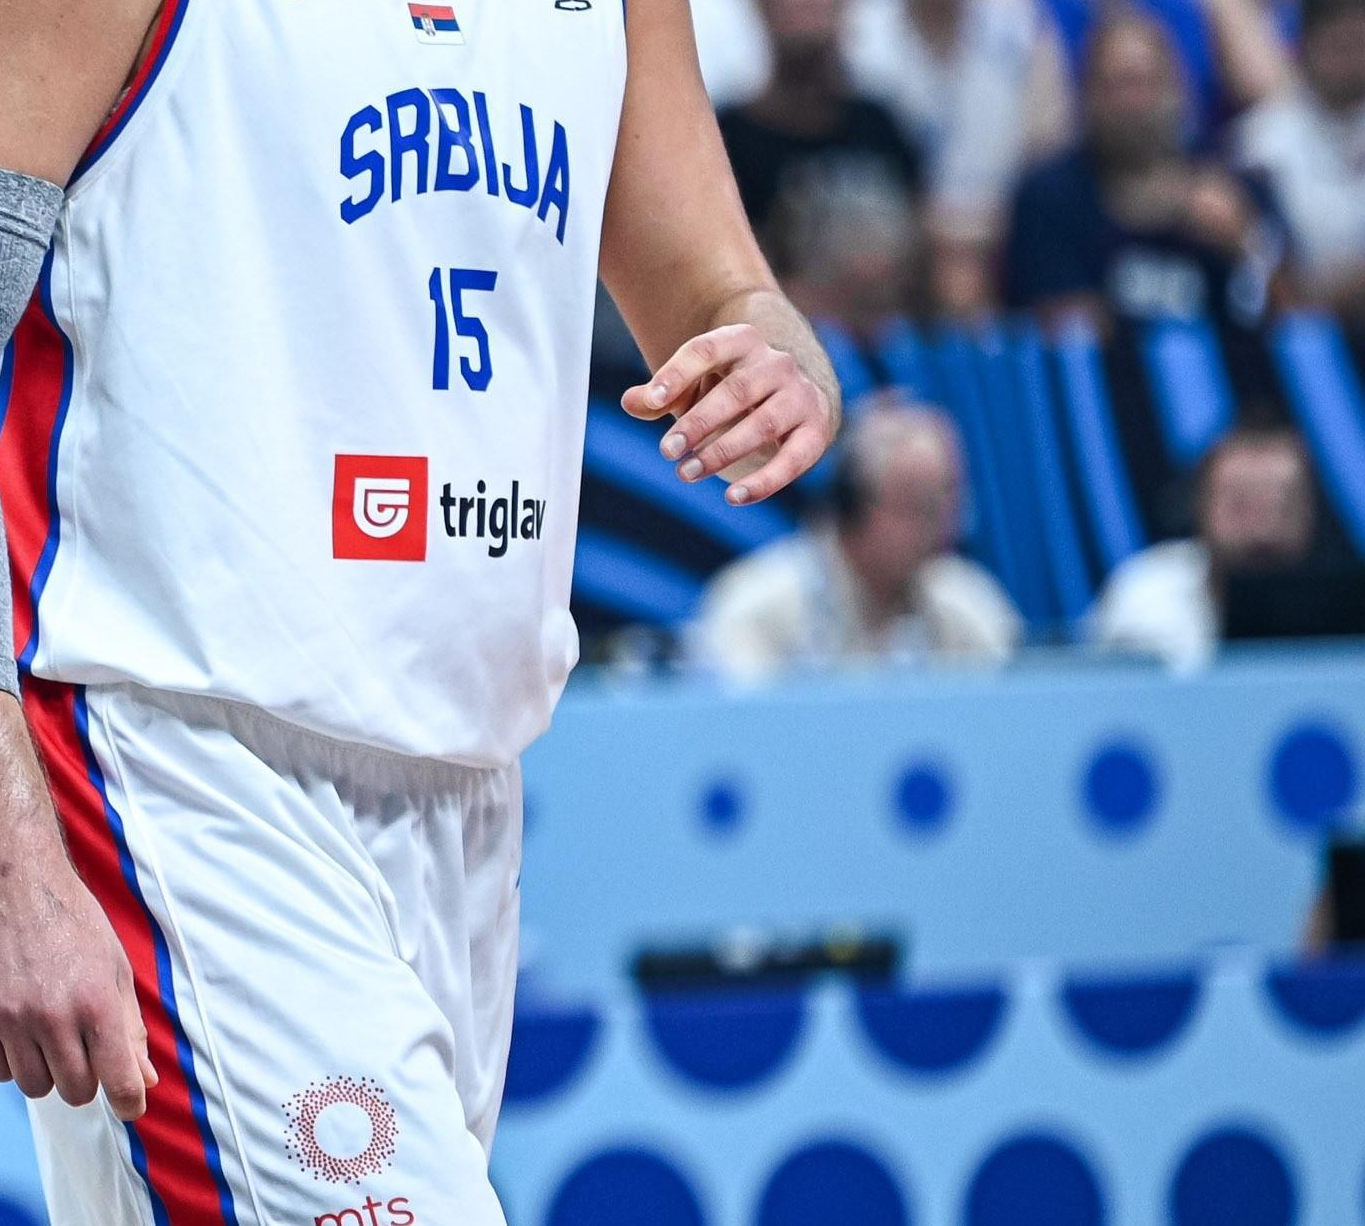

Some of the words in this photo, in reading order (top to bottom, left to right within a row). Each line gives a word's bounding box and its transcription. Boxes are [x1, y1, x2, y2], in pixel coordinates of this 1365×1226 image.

[340, 87, 570, 246] SRBIJA
[429, 266, 498, 392] 15
[314, 1195, 414, 1226] mts
